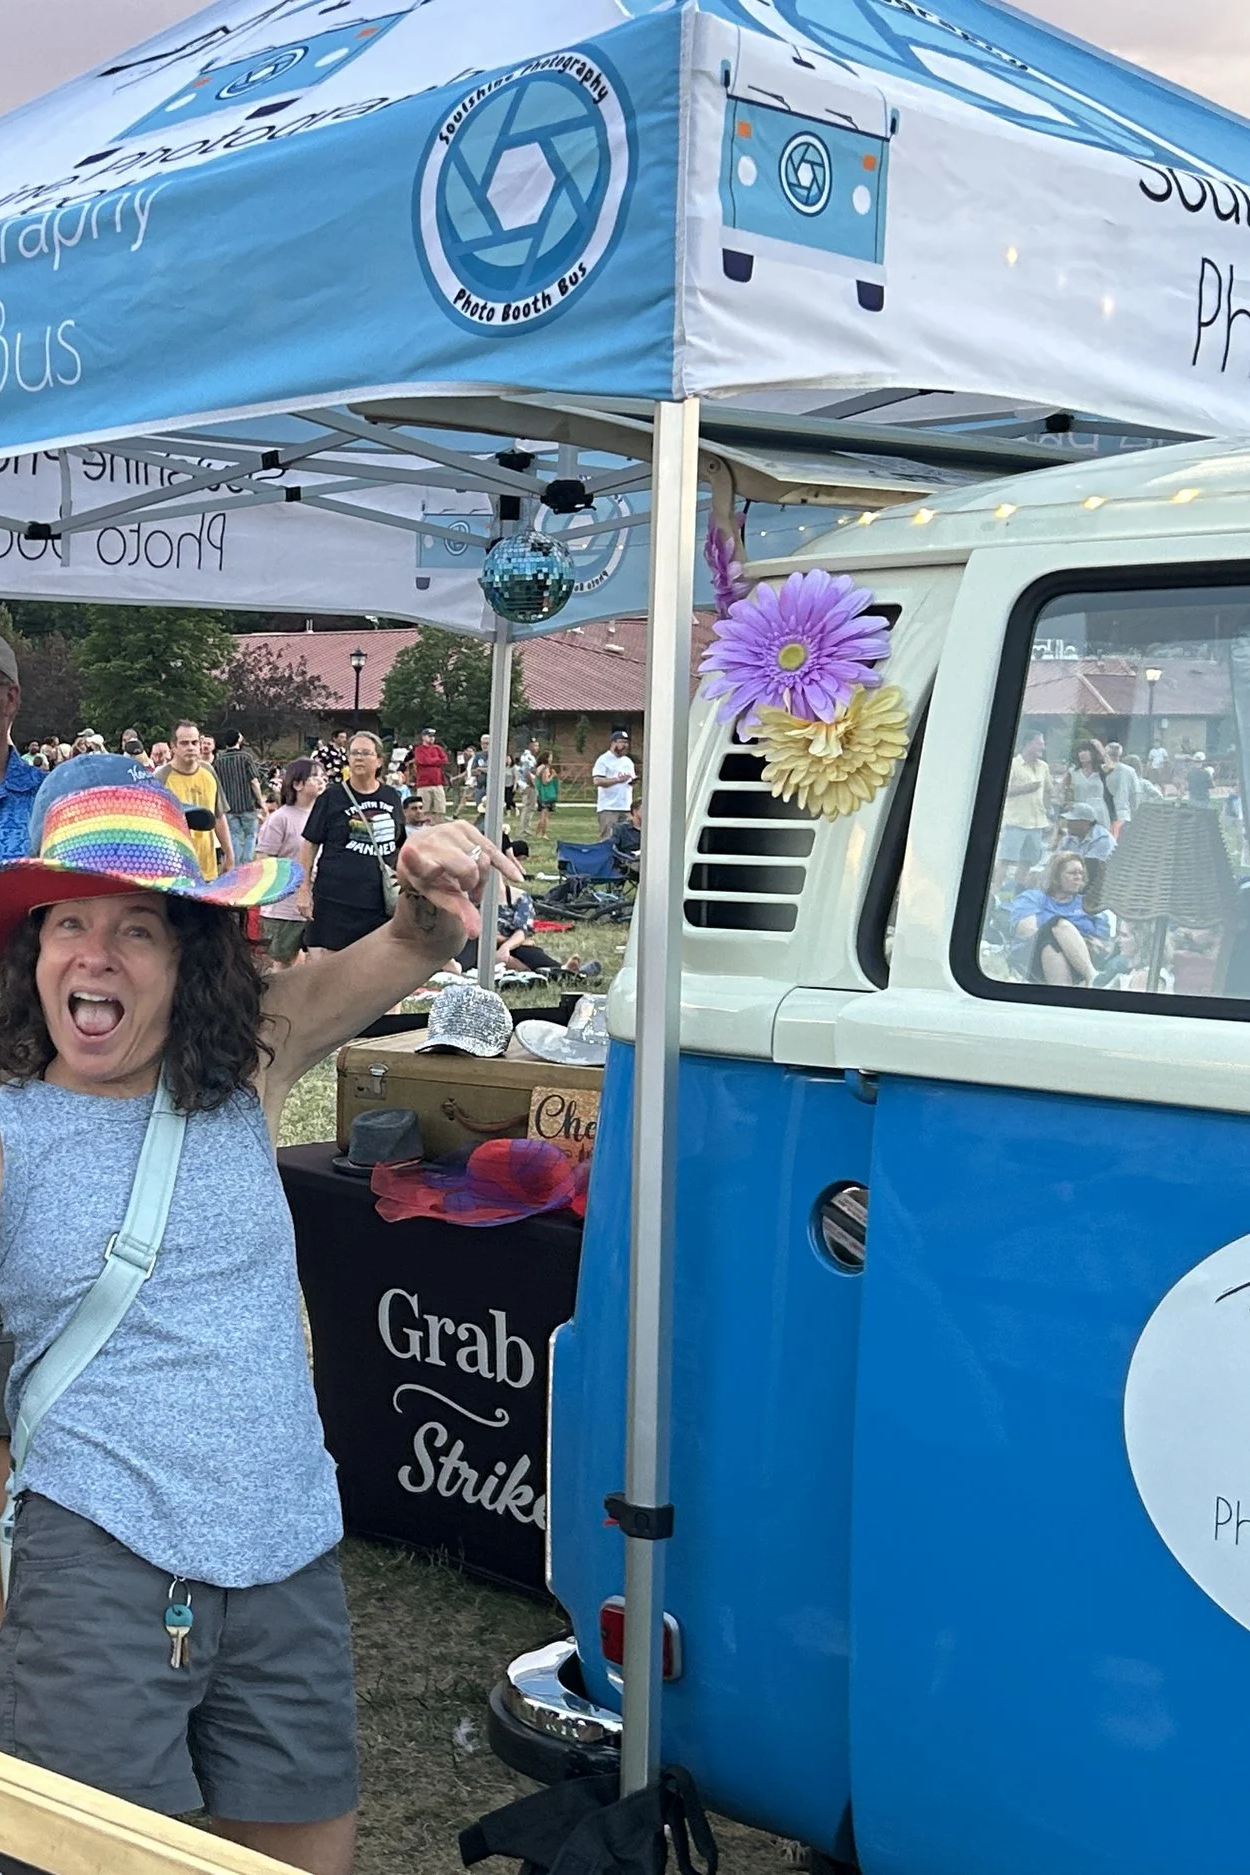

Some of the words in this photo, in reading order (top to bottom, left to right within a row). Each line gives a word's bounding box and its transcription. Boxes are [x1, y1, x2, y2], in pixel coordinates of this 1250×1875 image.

[439, 74, 515, 146] Soulshine
[521, 54, 608, 105] Photography
[453, 288, 495, 322] Photo
[502, 292, 551, 322] Booth
[558, 262, 587, 297] Bus
[378, 1288, 535, 1389] Grab
